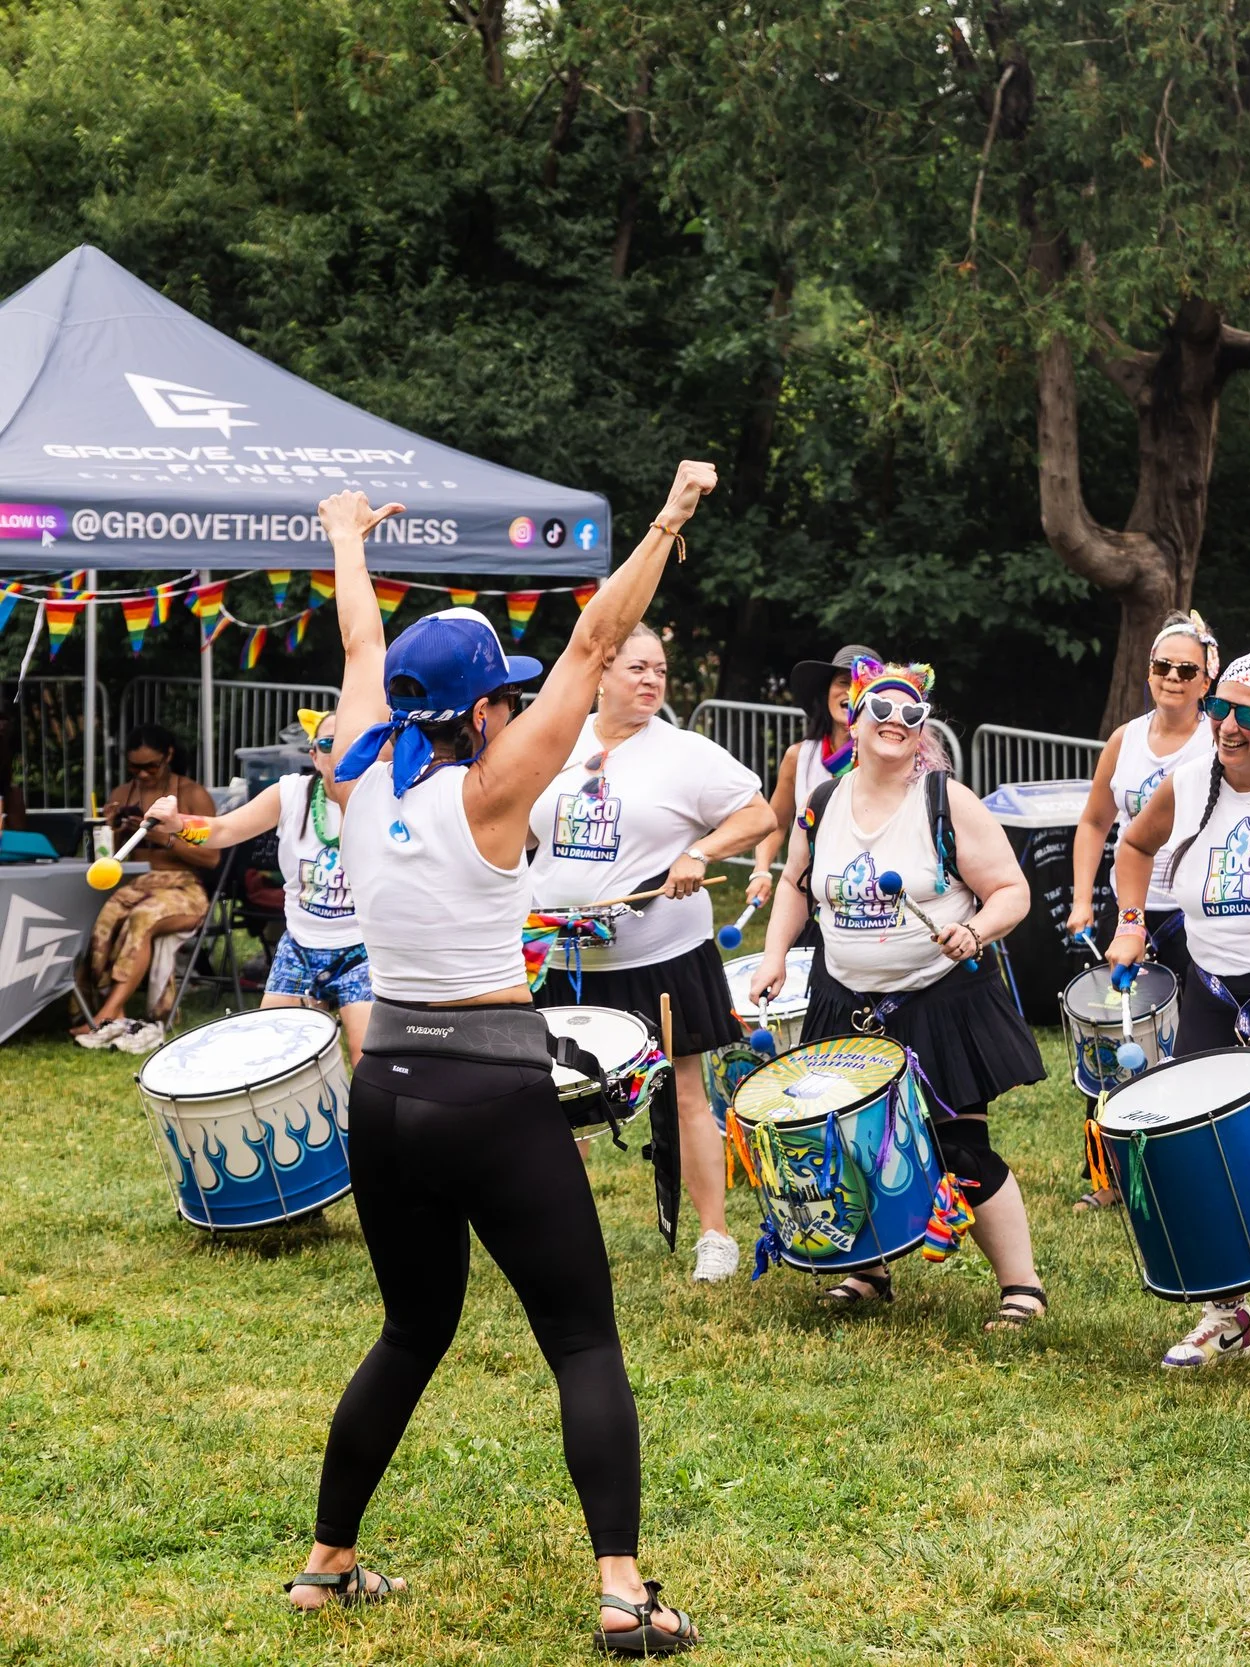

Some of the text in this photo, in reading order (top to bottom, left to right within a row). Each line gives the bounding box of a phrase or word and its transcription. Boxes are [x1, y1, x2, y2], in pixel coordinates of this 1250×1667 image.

[43, 444, 416, 465] GROOVE THEORY
[167, 464, 348, 478] FITNESS
[36, 515, 57, 528] US
[72, 508, 459, 545] @GROOVETHEORTNESS
[559, 794, 618, 822] FOGO
[556, 819, 617, 847] AZUL
[569, 847, 615, 861] DRUMLINE
[1206, 905, 1220, 914] NJ
[847, 917, 900, 928] DRUMLIN
[811, 1219, 850, 1249] AZUL
